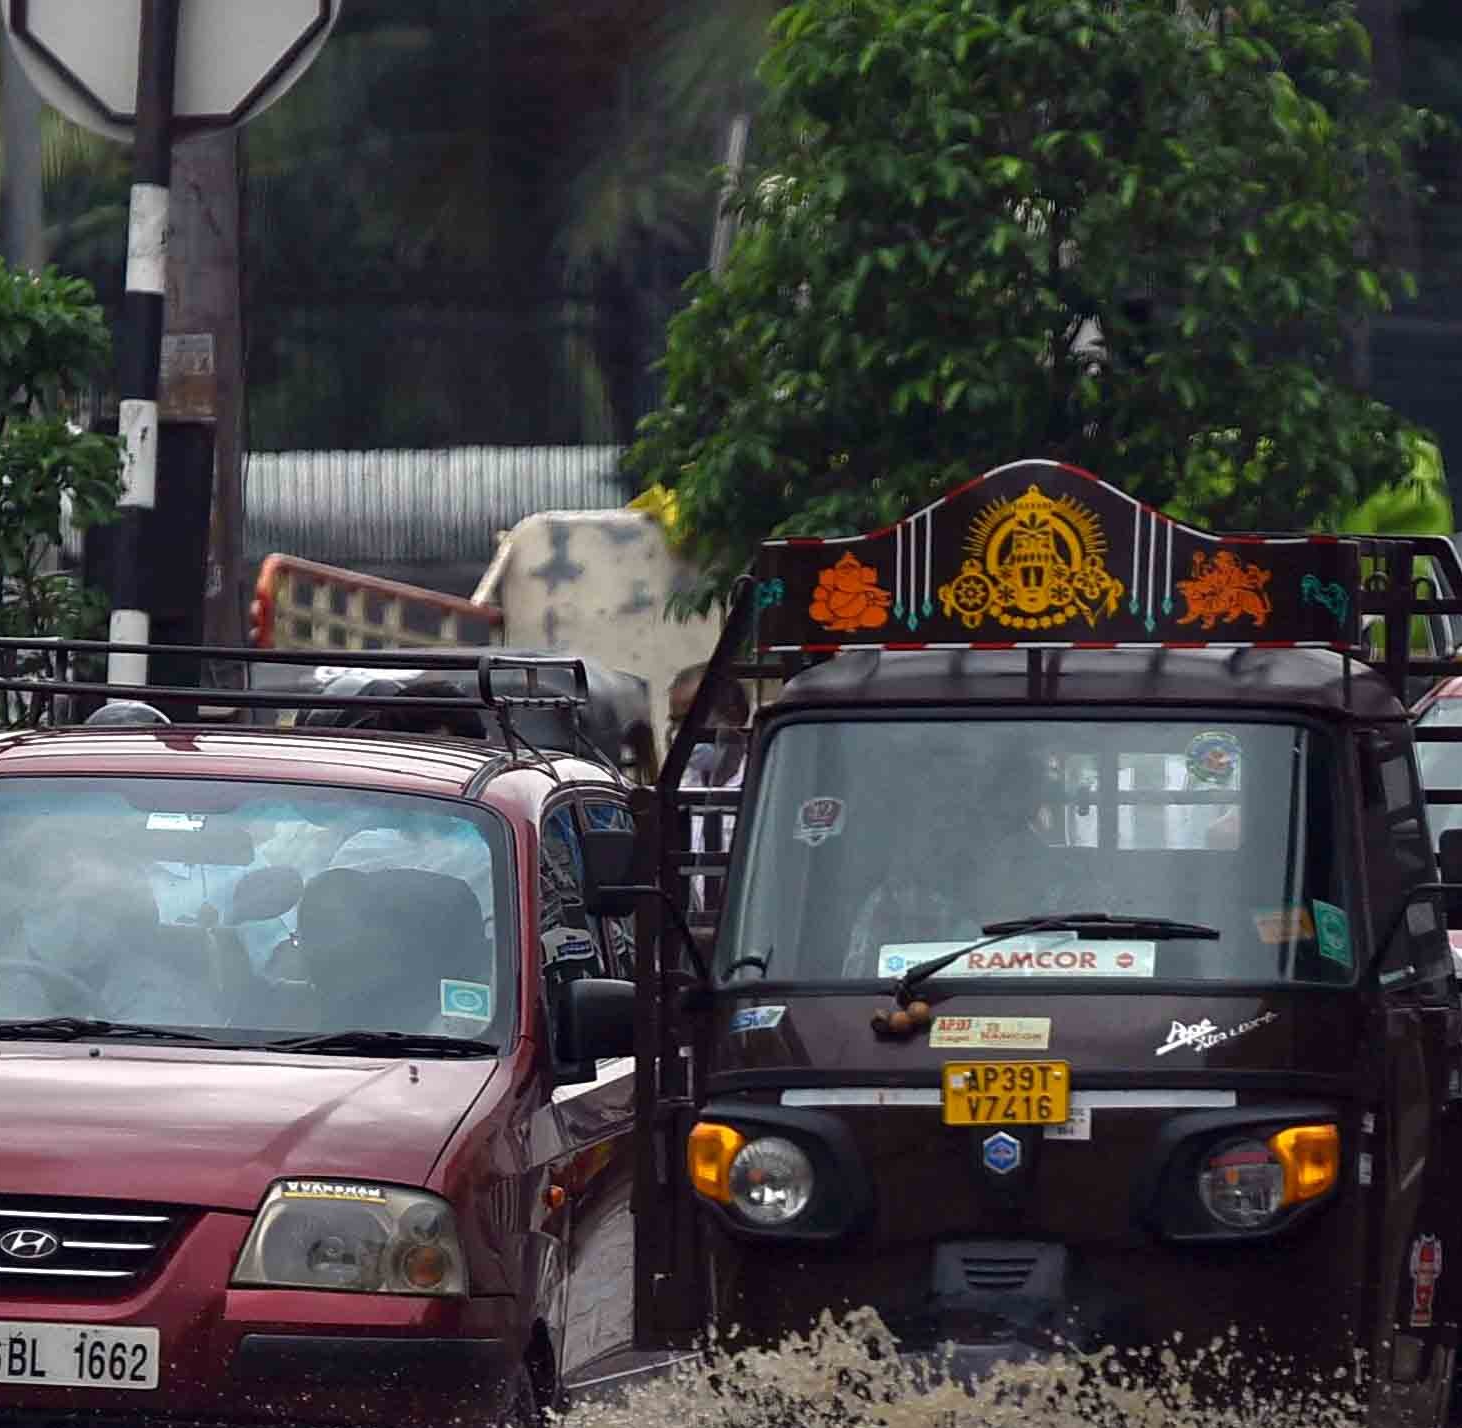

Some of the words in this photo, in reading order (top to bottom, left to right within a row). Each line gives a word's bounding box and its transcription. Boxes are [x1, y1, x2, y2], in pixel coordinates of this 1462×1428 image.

[967, 951, 1097, 969] RAMCOR
[966, 1064, 1051, 1092] AP39T
[967, 1095, 1052, 1121] V7416
[73, 1339, 149, 1382] 1662
